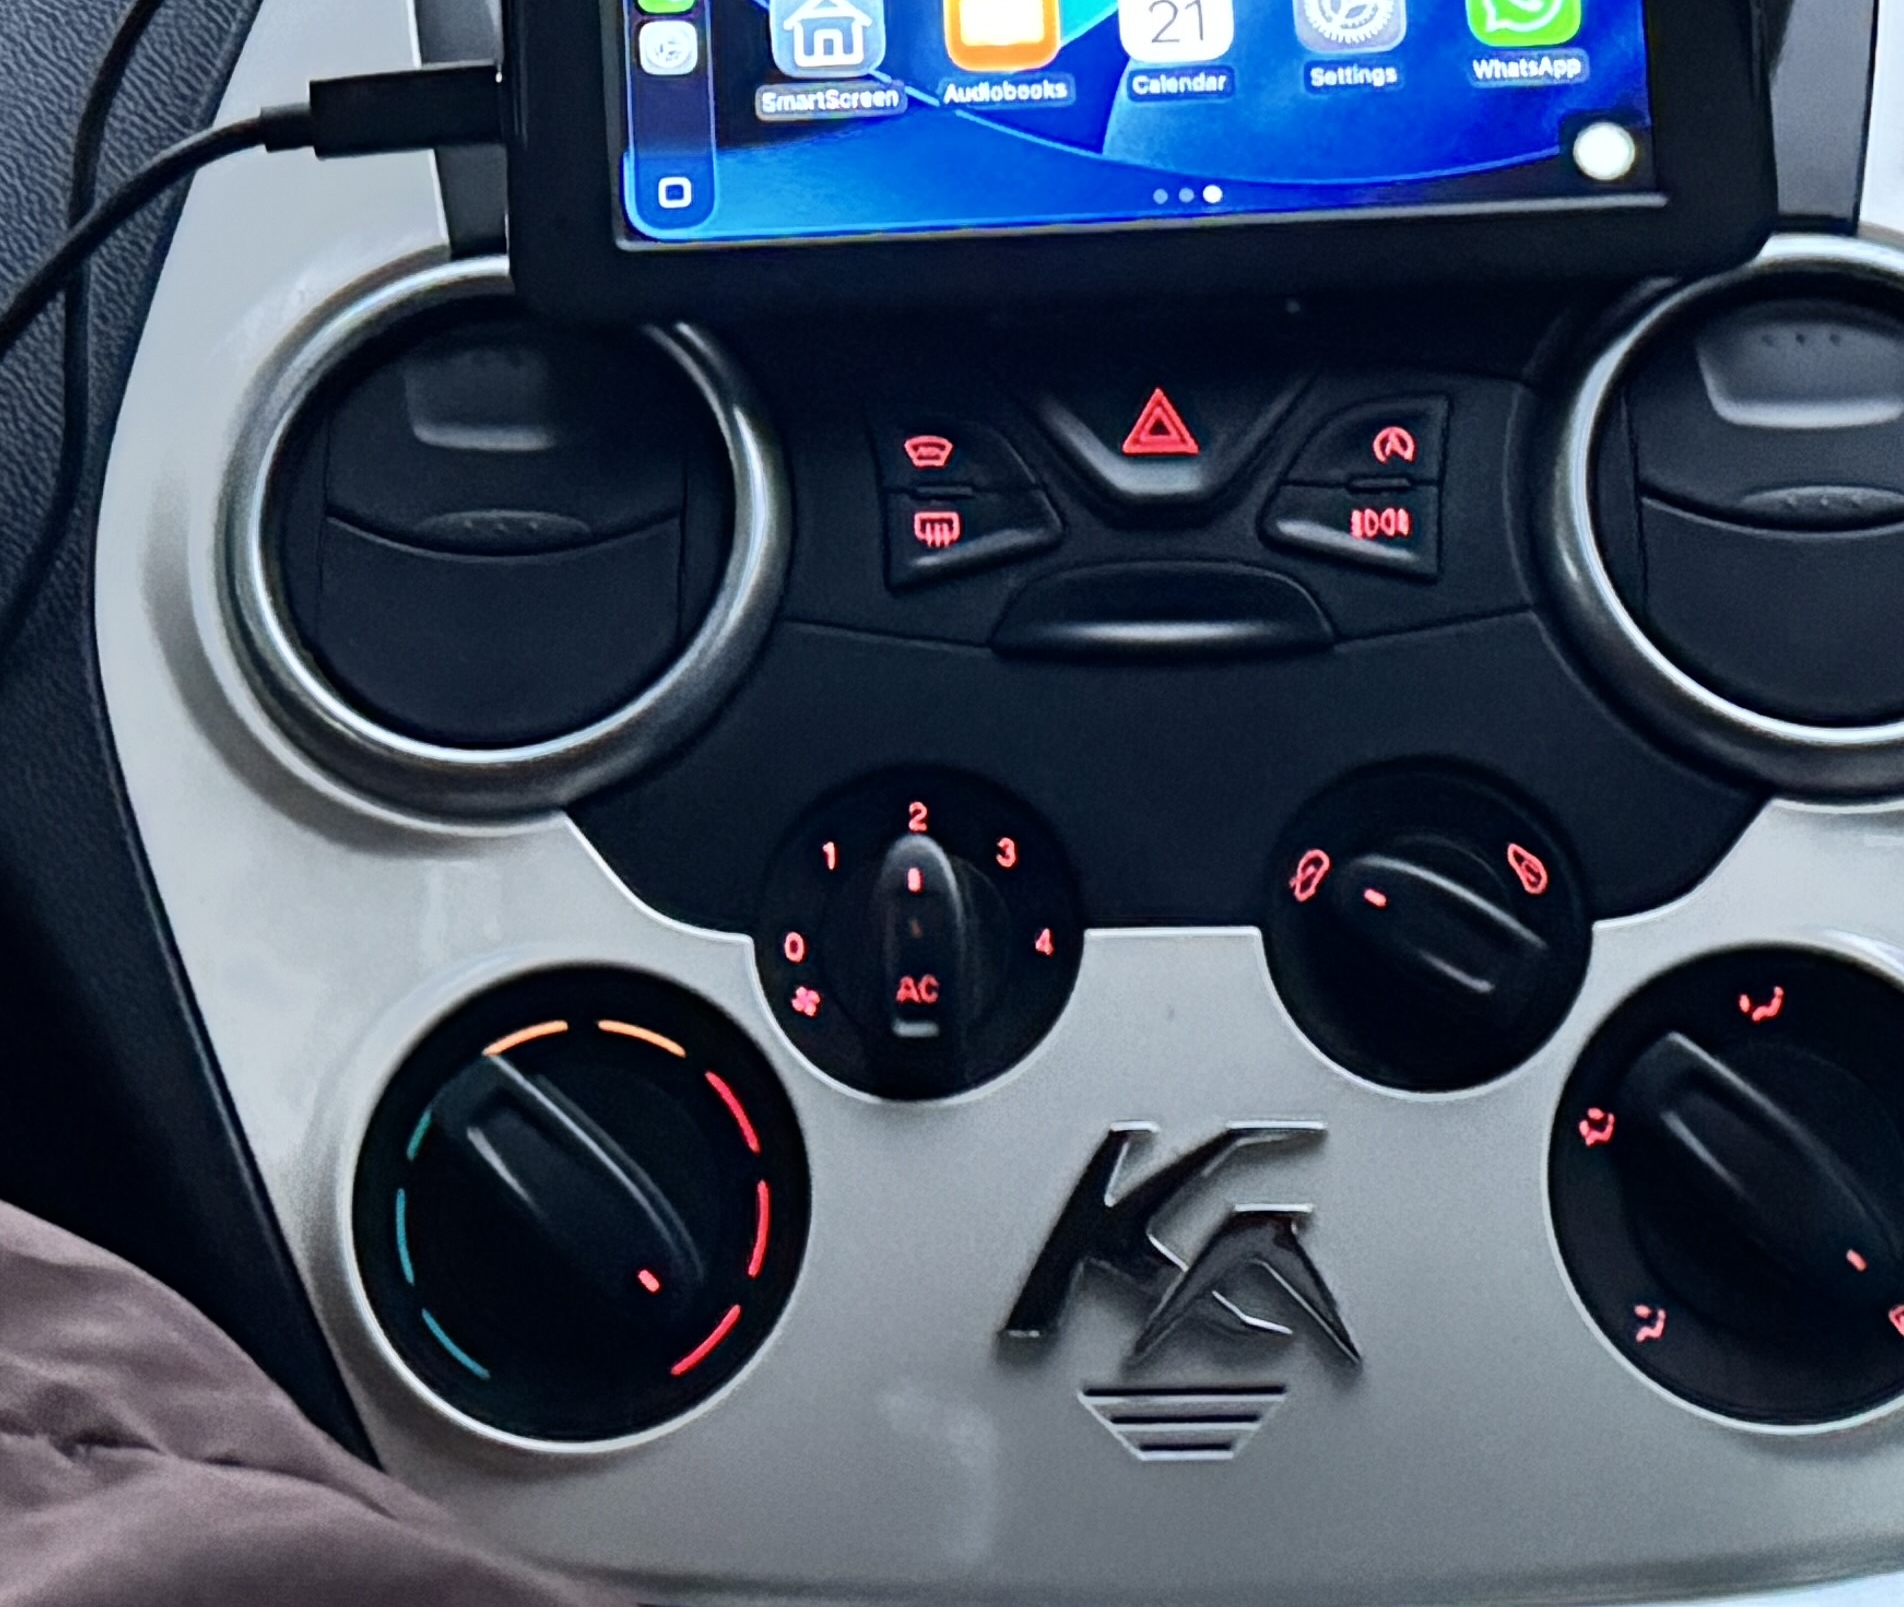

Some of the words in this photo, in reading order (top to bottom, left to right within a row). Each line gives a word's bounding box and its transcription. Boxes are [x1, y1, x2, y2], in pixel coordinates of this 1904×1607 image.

[1310, 64, 1398, 87] Settings
[1472, 57, 1582, 80] WhatsApp
[943, 80, 1068, 104] Audiobooks
[1132, 73, 1227, 95] Calendar
[762, 87, 899, 113] SmartScreen
[908, 801, 928, 832] 2
[823, 842, 836, 870] 1
[996, 837, 1017, 868] 3
[784, 931, 805, 963] 0
[1035, 928, 1054, 956] 4
[896, 975, 940, 1004] AC
